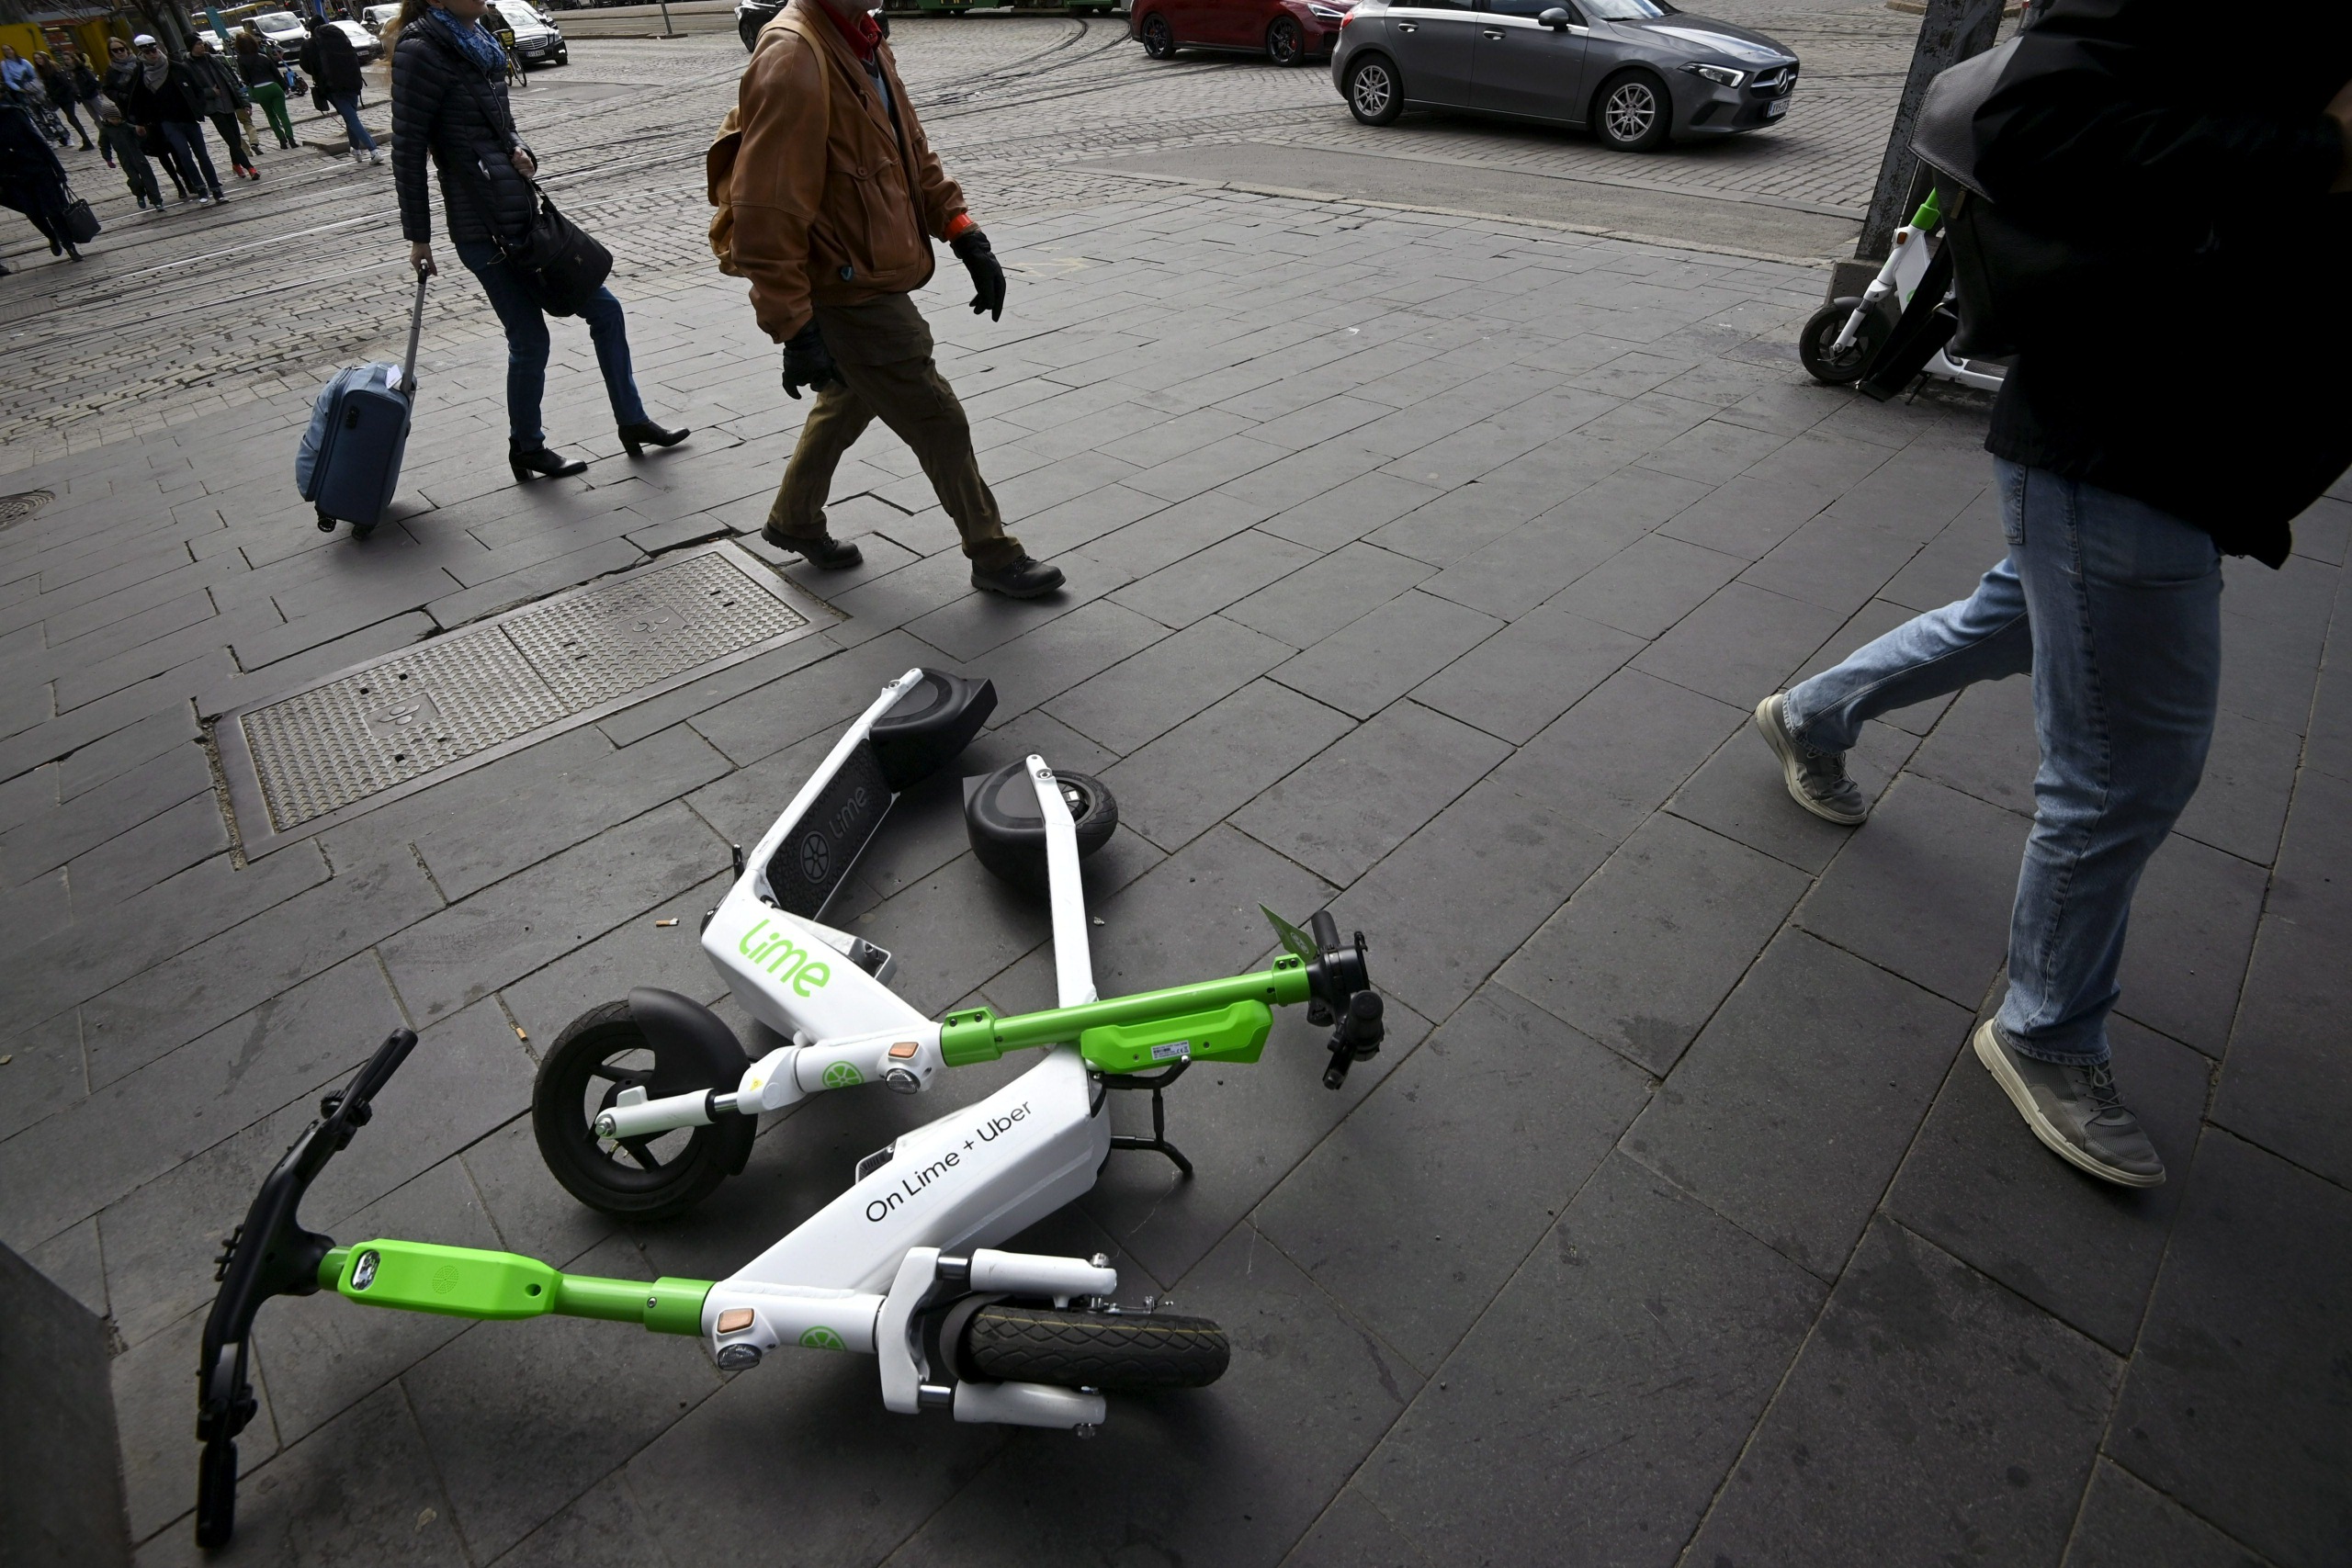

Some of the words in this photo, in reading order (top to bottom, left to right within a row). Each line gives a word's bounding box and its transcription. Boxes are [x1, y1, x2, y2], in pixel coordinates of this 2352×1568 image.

[866, 1192, 904, 1223] On
[901, 1151, 961, 1197] Lime
[963, 1139, 975, 1151] +
[976, 1100, 1033, 1143] Uber
